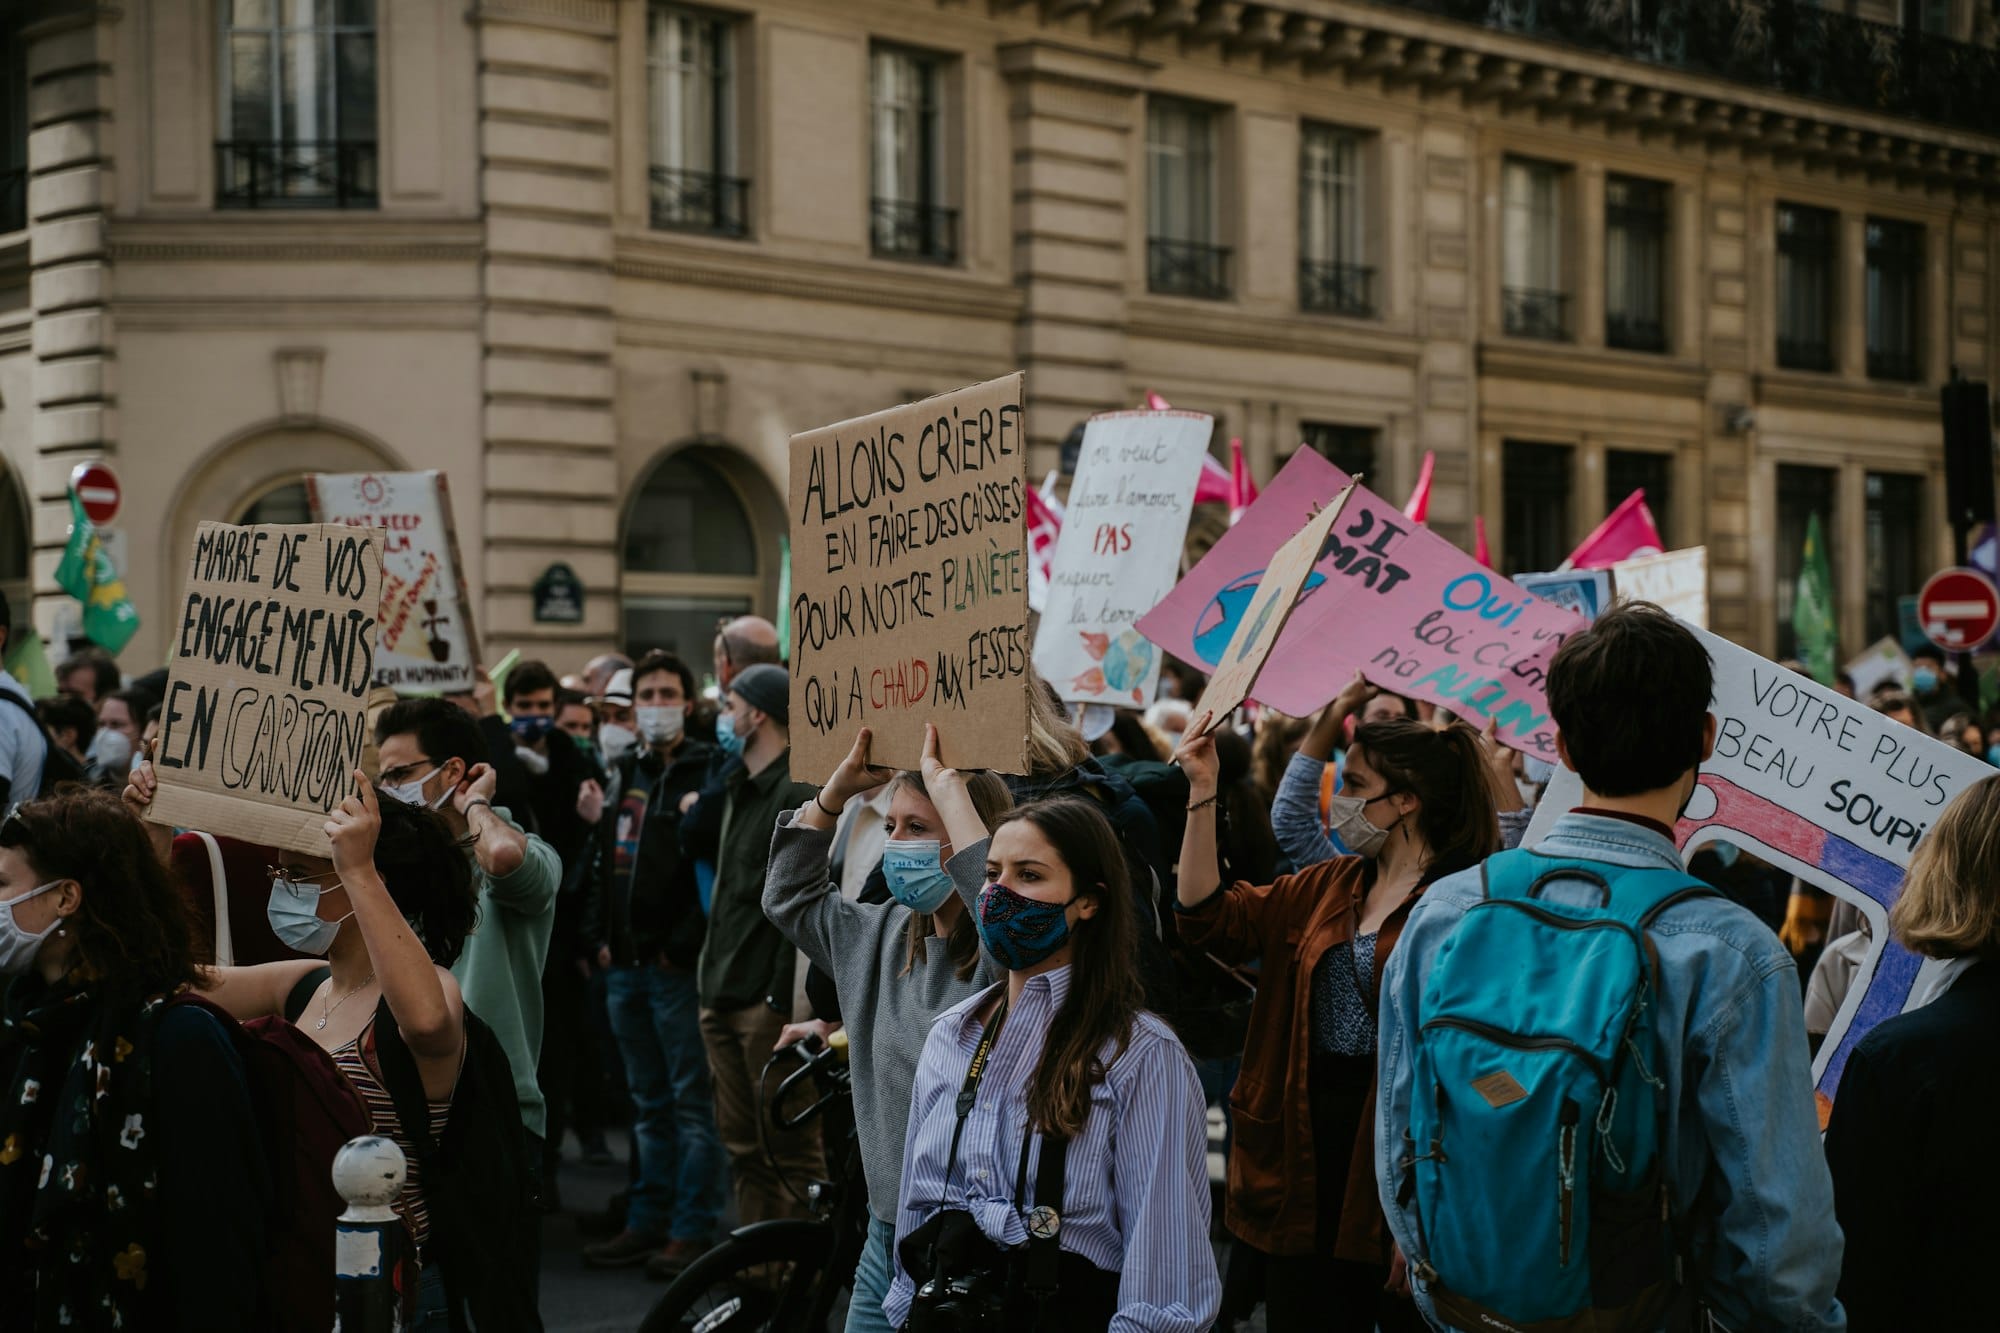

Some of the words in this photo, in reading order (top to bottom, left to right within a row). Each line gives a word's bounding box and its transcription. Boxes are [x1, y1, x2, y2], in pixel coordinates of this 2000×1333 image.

[803, 426, 905, 525] ALLONS
[1000, 405, 1021, 455] ET
[1119, 434, 1167, 464] veut
[380, 513, 422, 531] KEEP
[826, 523, 856, 573] EN
[925, 498, 958, 545] DES
[1093, 522, 1132, 555] PAS
[194, 530, 267, 583] MARRE
[272, 533, 307, 592] DE
[326, 537, 370, 601] VOS
[794, 585, 855, 678] POUR
[862, 571, 934, 636] NOTRE
[942, 538, 1021, 611] PLANÈTE
[1067, 597, 1088, 624] la
[1414, 610, 1474, 654] loi
[180, 593, 375, 698] ENGAGEMENTS
[405, 665, 472, 684] HUMANITY
[848, 666, 864, 720] A
[870, 657, 929, 710] CHAUD
[933, 651, 966, 710] AUX
[968, 624, 1025, 690] FESSES
[160, 681, 219, 771] EN
[221, 687, 365, 813] CARTON
[1753, 668, 1863, 752] VOTRE
[1870, 734, 1951, 806] PLUS
[1715, 717, 1815, 788] BEAU
[1824, 779, 1927, 853] SOUPi
[970, 1040, 989, 1077] Nikon
